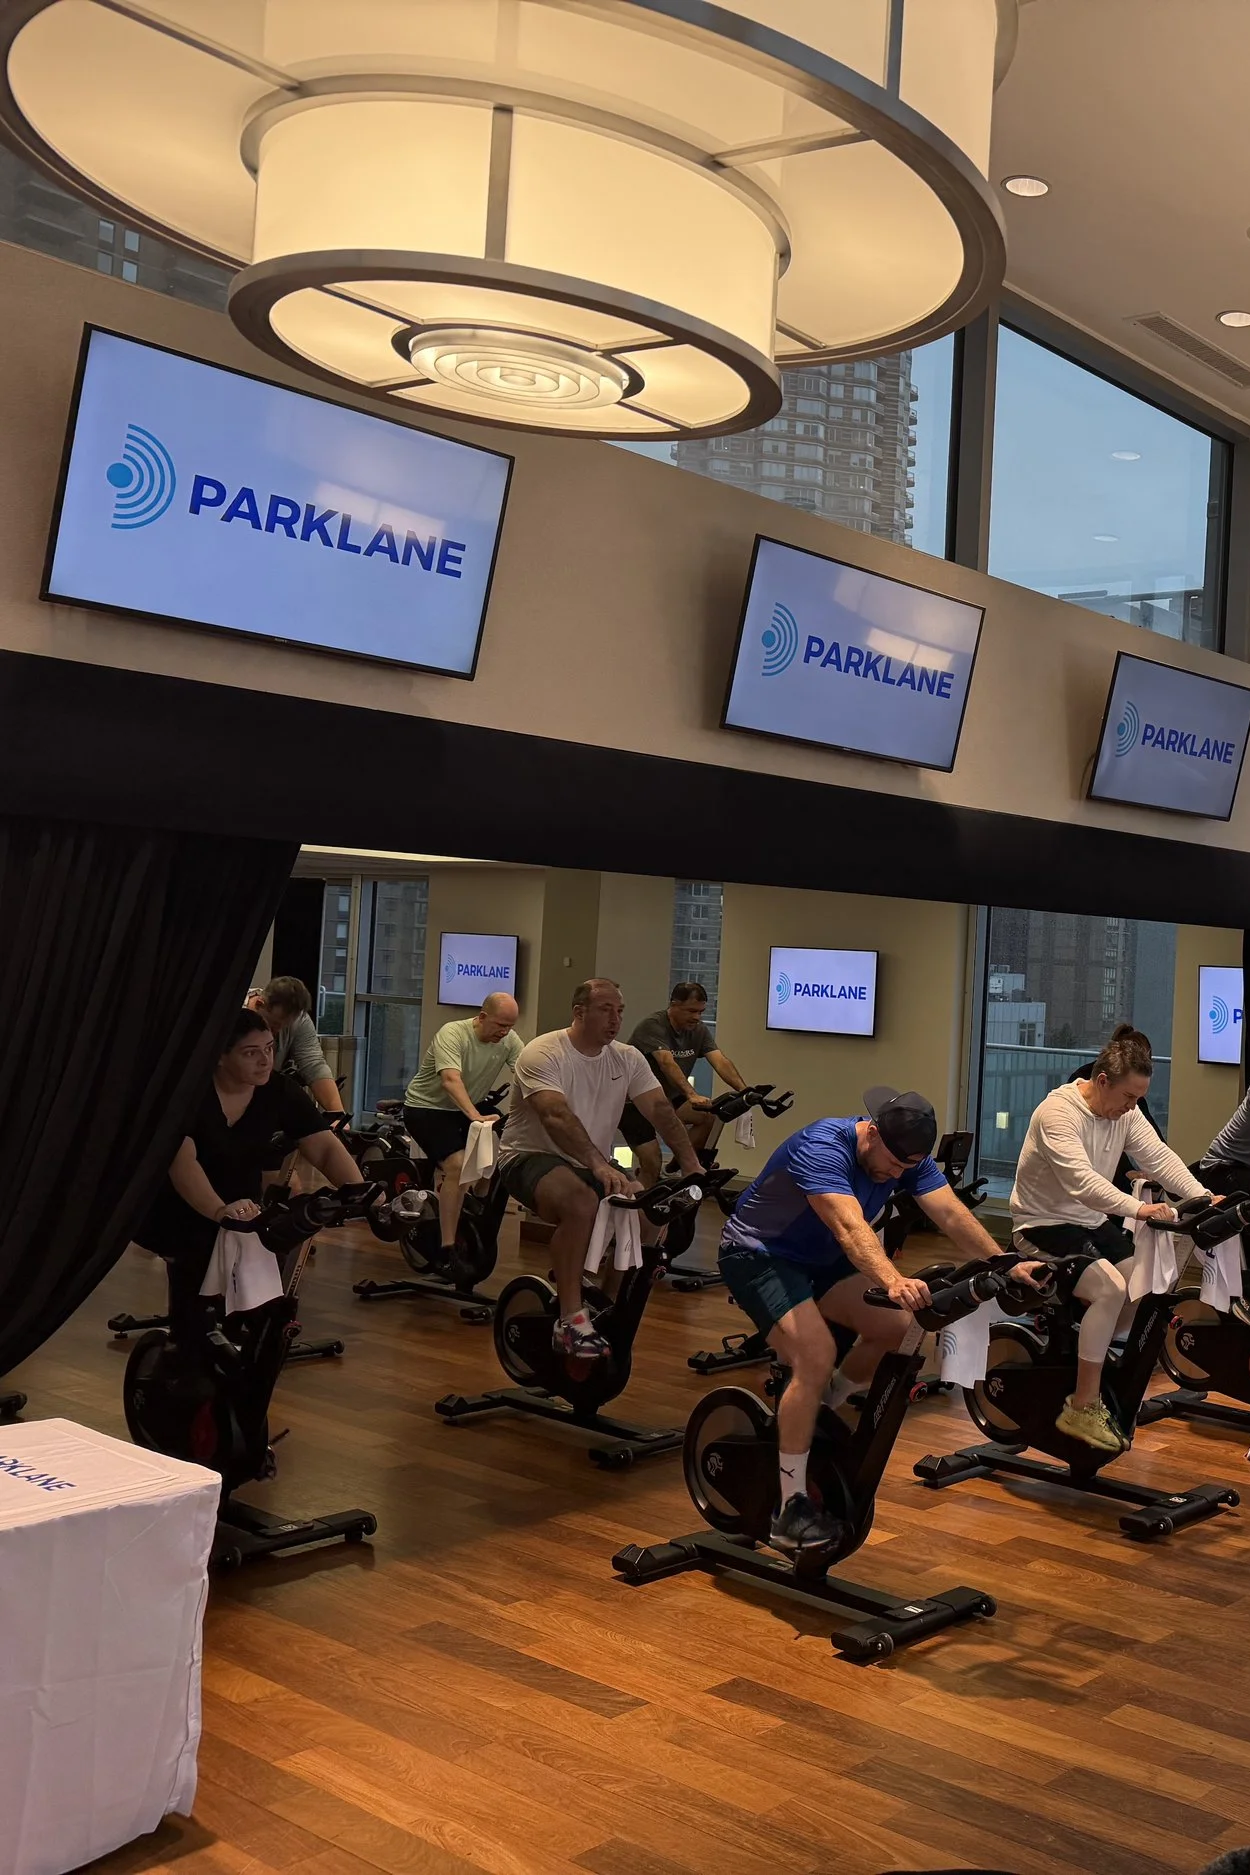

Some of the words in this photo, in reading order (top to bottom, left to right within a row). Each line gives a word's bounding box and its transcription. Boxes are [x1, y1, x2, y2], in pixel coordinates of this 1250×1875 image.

[188, 474, 467, 579] PARKLANE
[803, 634, 955, 700] PARKLANE
[1141, 723, 1236, 765] PARKLANE
[457, 963, 510, 979] PARKLANE
[793, 982, 867, 1001] PARKLANE
[0, 1455, 77, 1492] RKLANE
